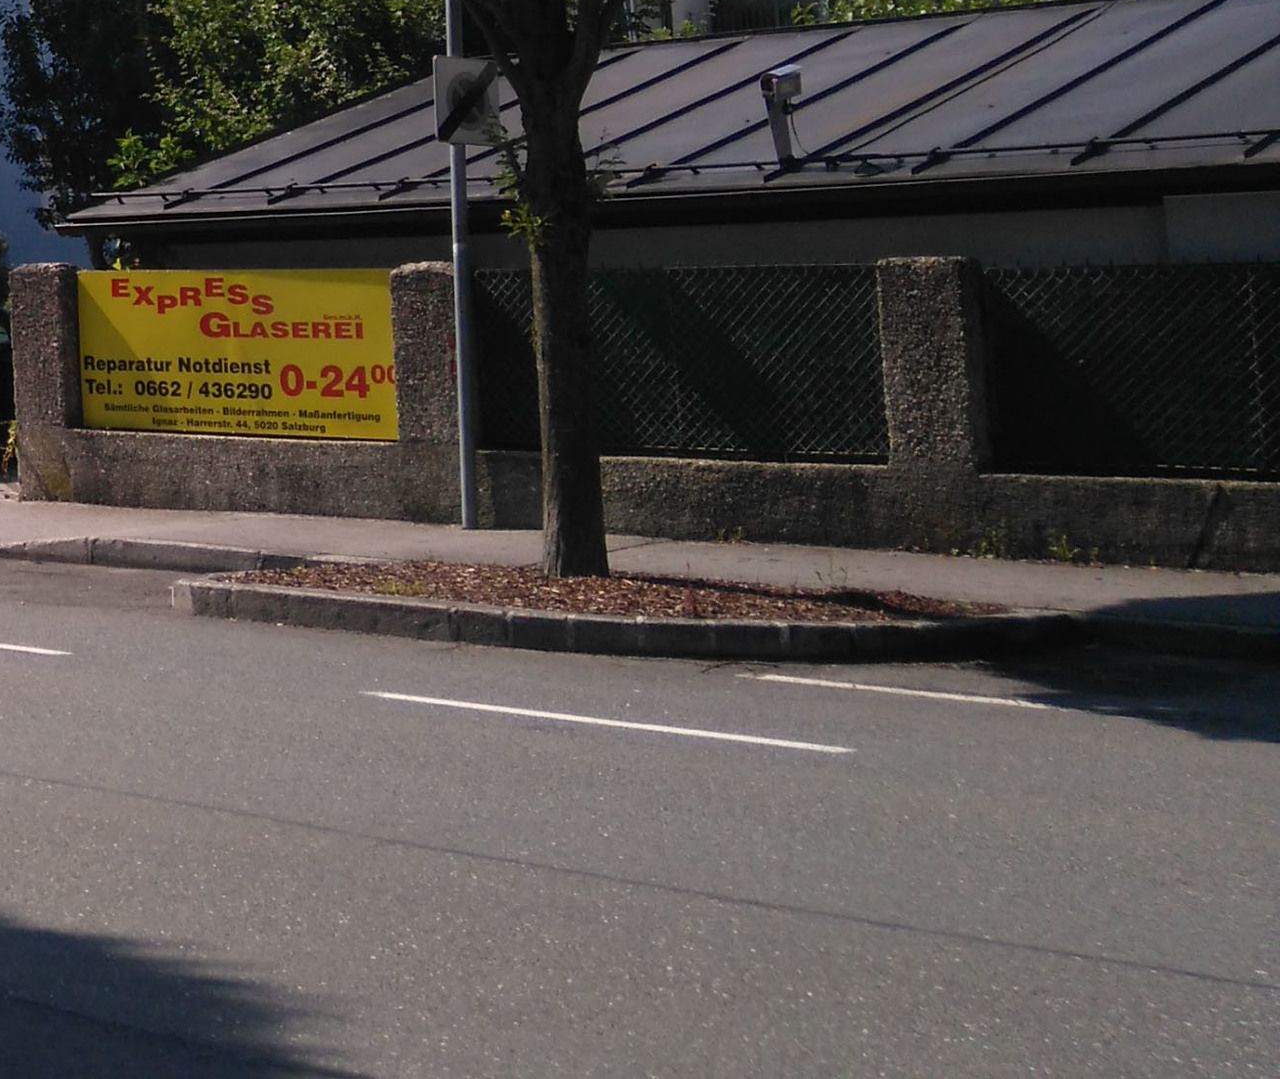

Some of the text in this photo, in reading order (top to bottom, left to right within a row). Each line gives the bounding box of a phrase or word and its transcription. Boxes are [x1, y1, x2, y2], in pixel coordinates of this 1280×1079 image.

[83, 356, 272, 375] Reparatur Notdienst
[85, 379, 124, 396] Tel.:
[134, 380, 182, 398] 0662
[198, 382, 273, 400] 436290
[104, 403, 149, 414] Sämtliche
[151, 404, 215, 416] Glasarbeiten
[222, 407, 290, 418] Bilderrahmen
[298, 409, 382, 424] Maßanfertigung
[254, 420, 279, 431] 5020
[281, 421, 327, 434] Salzburg
